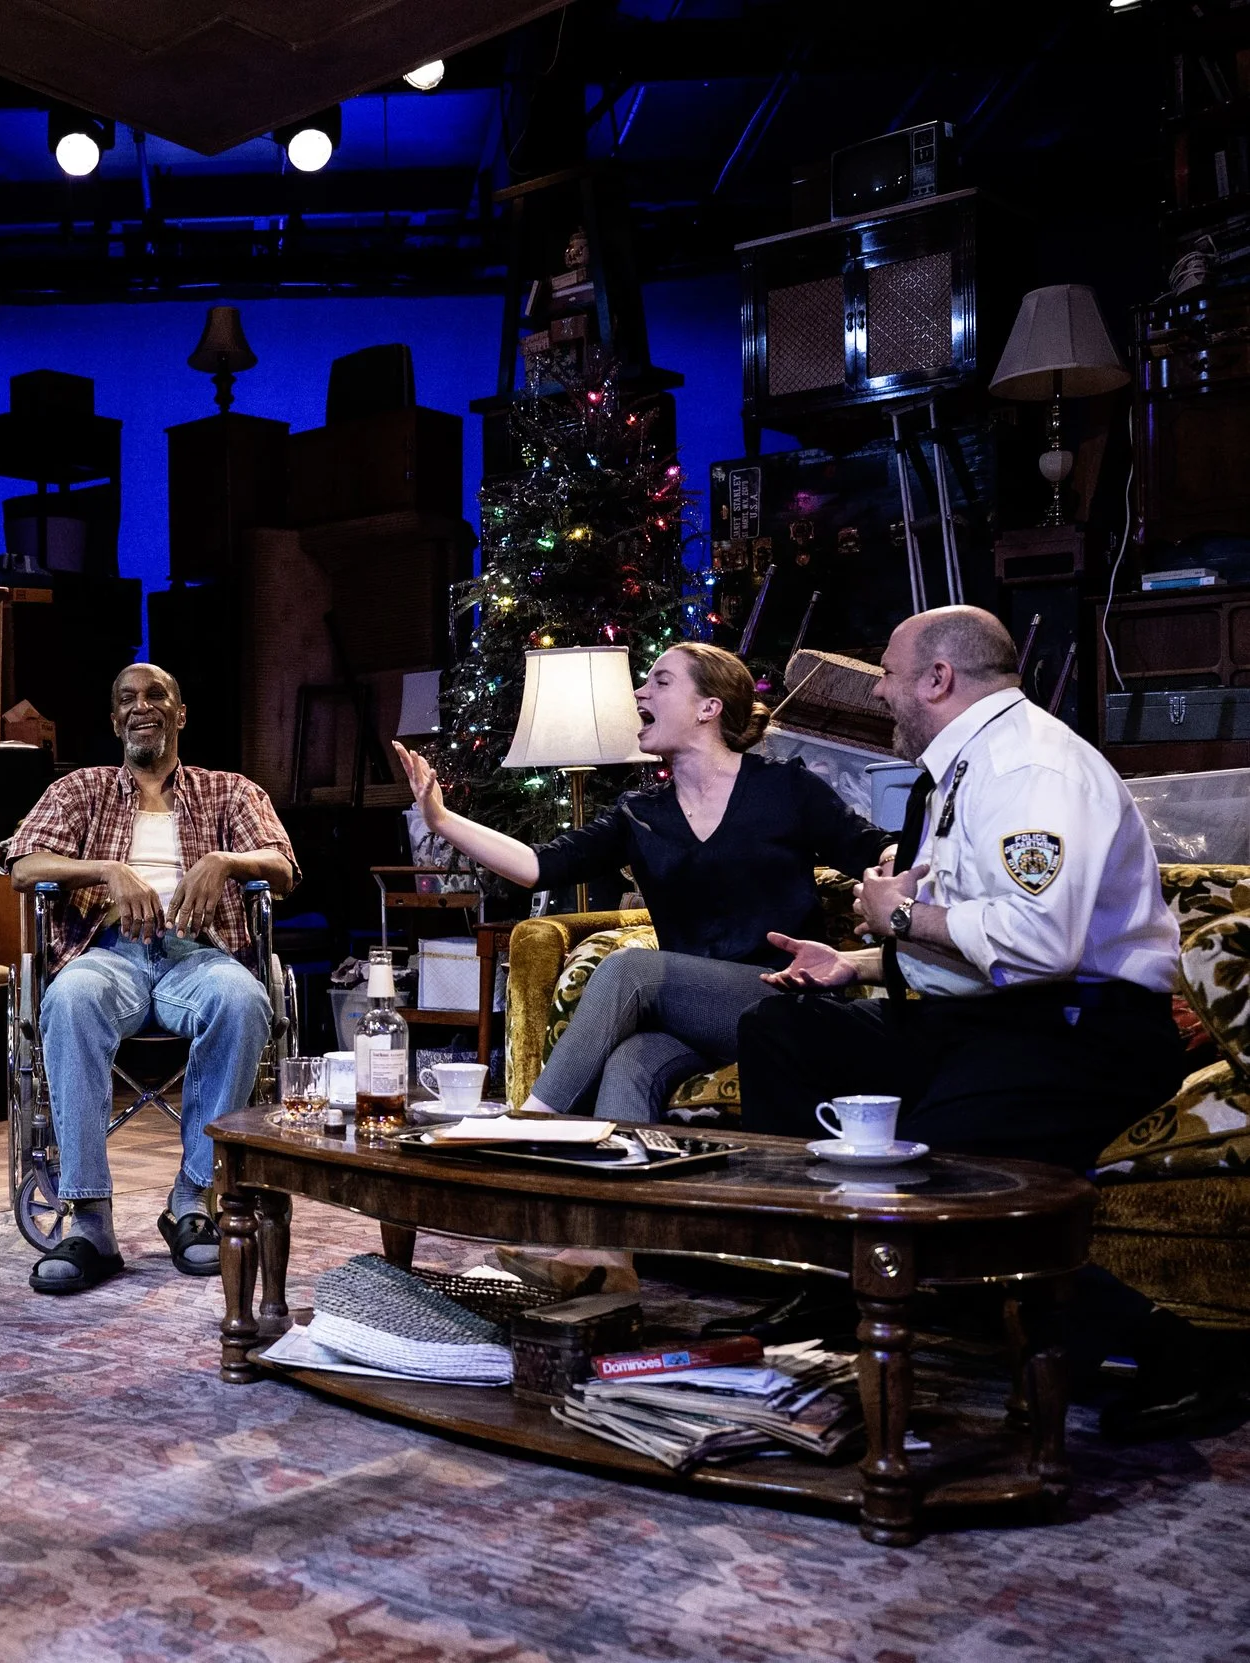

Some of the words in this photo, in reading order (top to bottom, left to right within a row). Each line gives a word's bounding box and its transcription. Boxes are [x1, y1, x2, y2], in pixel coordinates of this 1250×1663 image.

[733, 475, 742, 512] STANLEY
[1015, 834, 1048, 842] POLICE
[1004, 841, 1059, 854] DEPARTMENT
[602, 1357, 662, 1374] Dominoes
